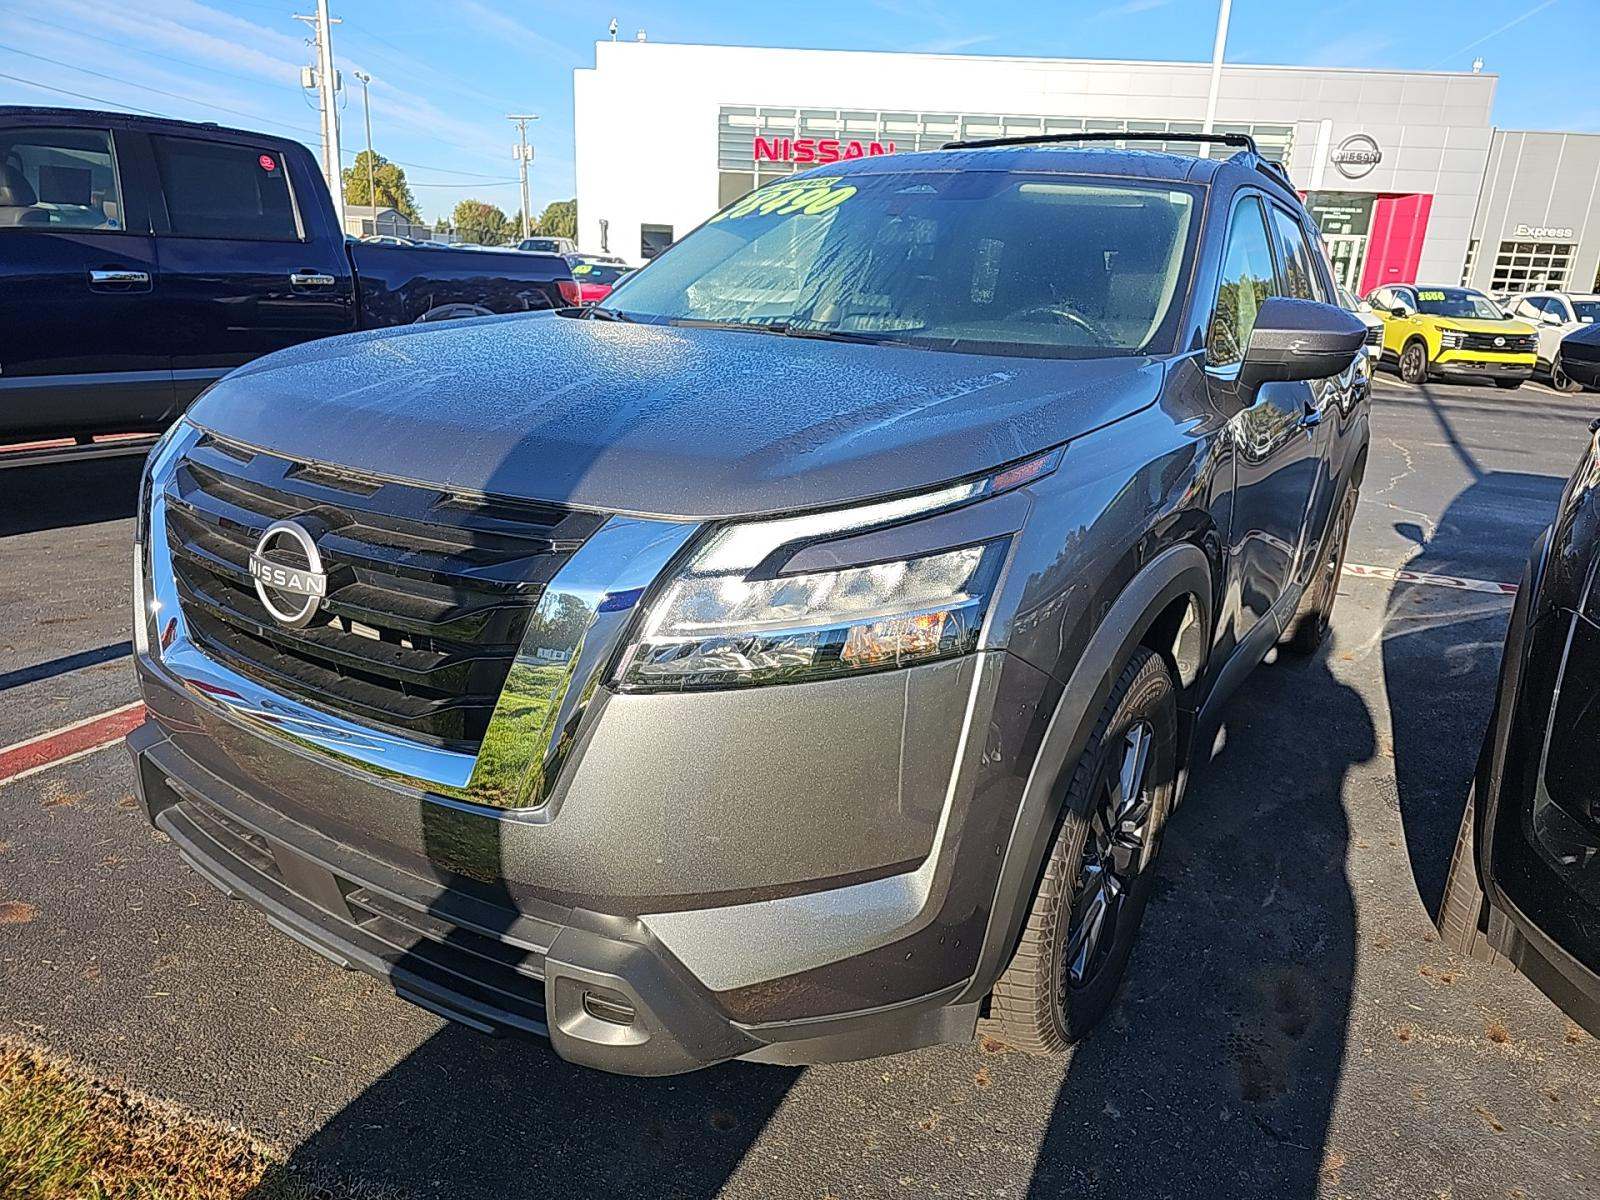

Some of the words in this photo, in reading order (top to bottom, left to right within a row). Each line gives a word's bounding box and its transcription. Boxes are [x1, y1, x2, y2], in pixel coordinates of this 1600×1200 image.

[754, 137, 896, 163] NISSAN
[1335, 151, 1377, 162] NISSAN
[1515, 224, 1573, 238] Express
[249, 557, 323, 595] NISSAN
